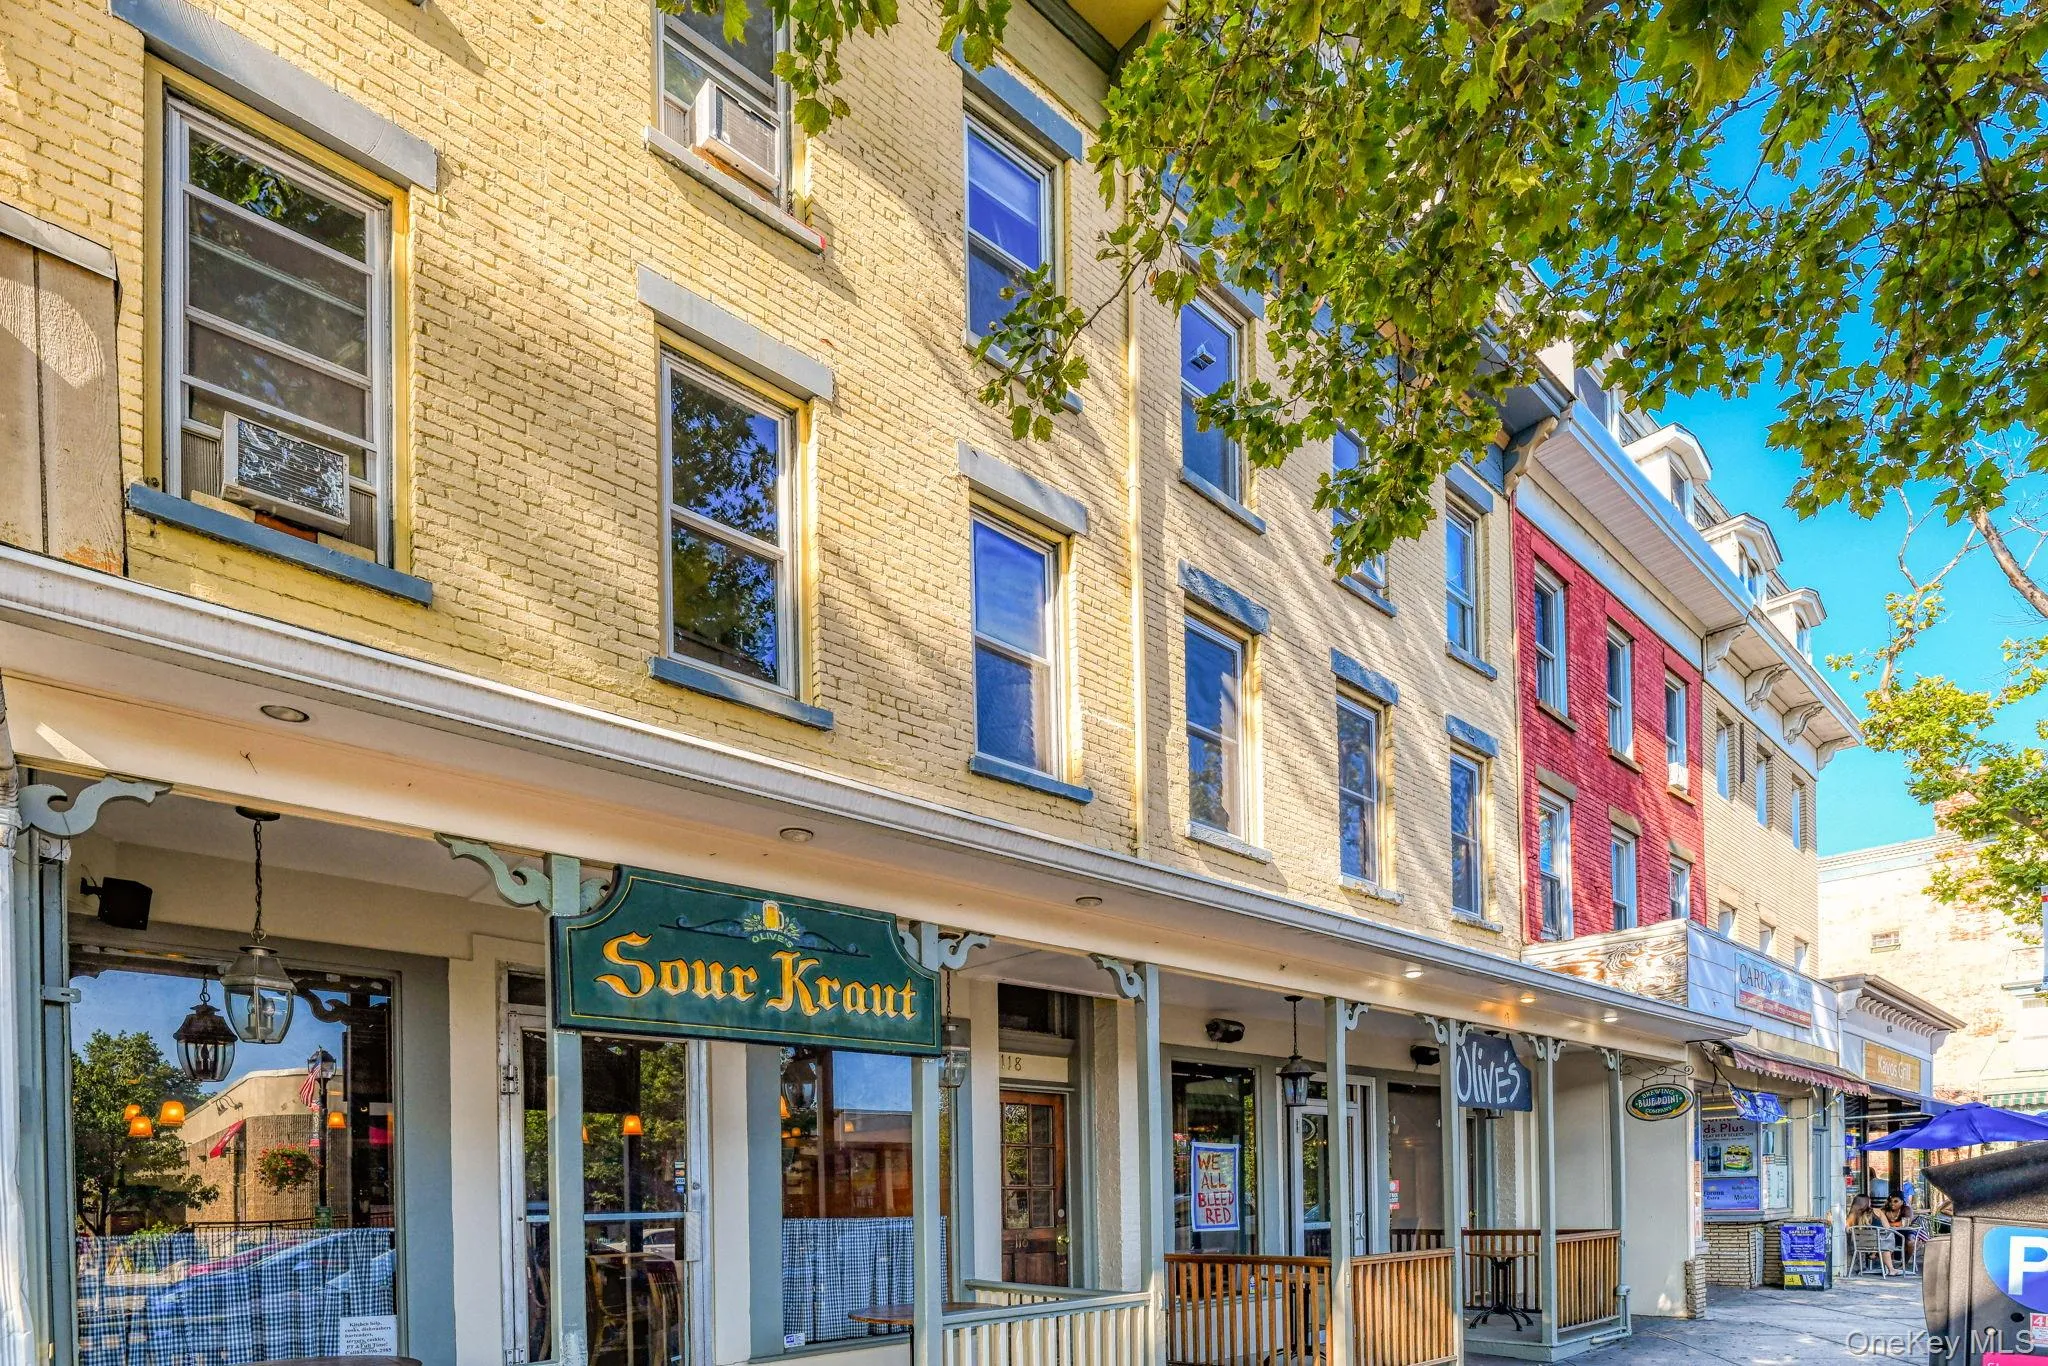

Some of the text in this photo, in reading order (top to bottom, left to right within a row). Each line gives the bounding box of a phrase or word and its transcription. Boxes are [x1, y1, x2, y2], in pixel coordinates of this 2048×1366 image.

[752, 932, 794, 948] OLIVE'S
[595, 931, 917, 1021] Sour Kraut
[1740, 963, 1773, 994] CARDS
[1001, 1053, 1022, 1072] 118
[1898, 1061, 1911, 1081] Grill
[1641, 1089, 1675, 1099] BREWING
[1656, 1094, 1679, 1105] POINT
[1645, 1105, 1673, 1114] COMPANY
[1720, 1123, 1745, 1133] Plus
[1198, 1153, 1221, 1171] WE
[1201, 1173, 1228, 1189] ALL
[1198, 1190, 1235, 1208] BLEED
[1205, 1207, 1232, 1224] RED
[2008, 1236, 2048, 1296] P
